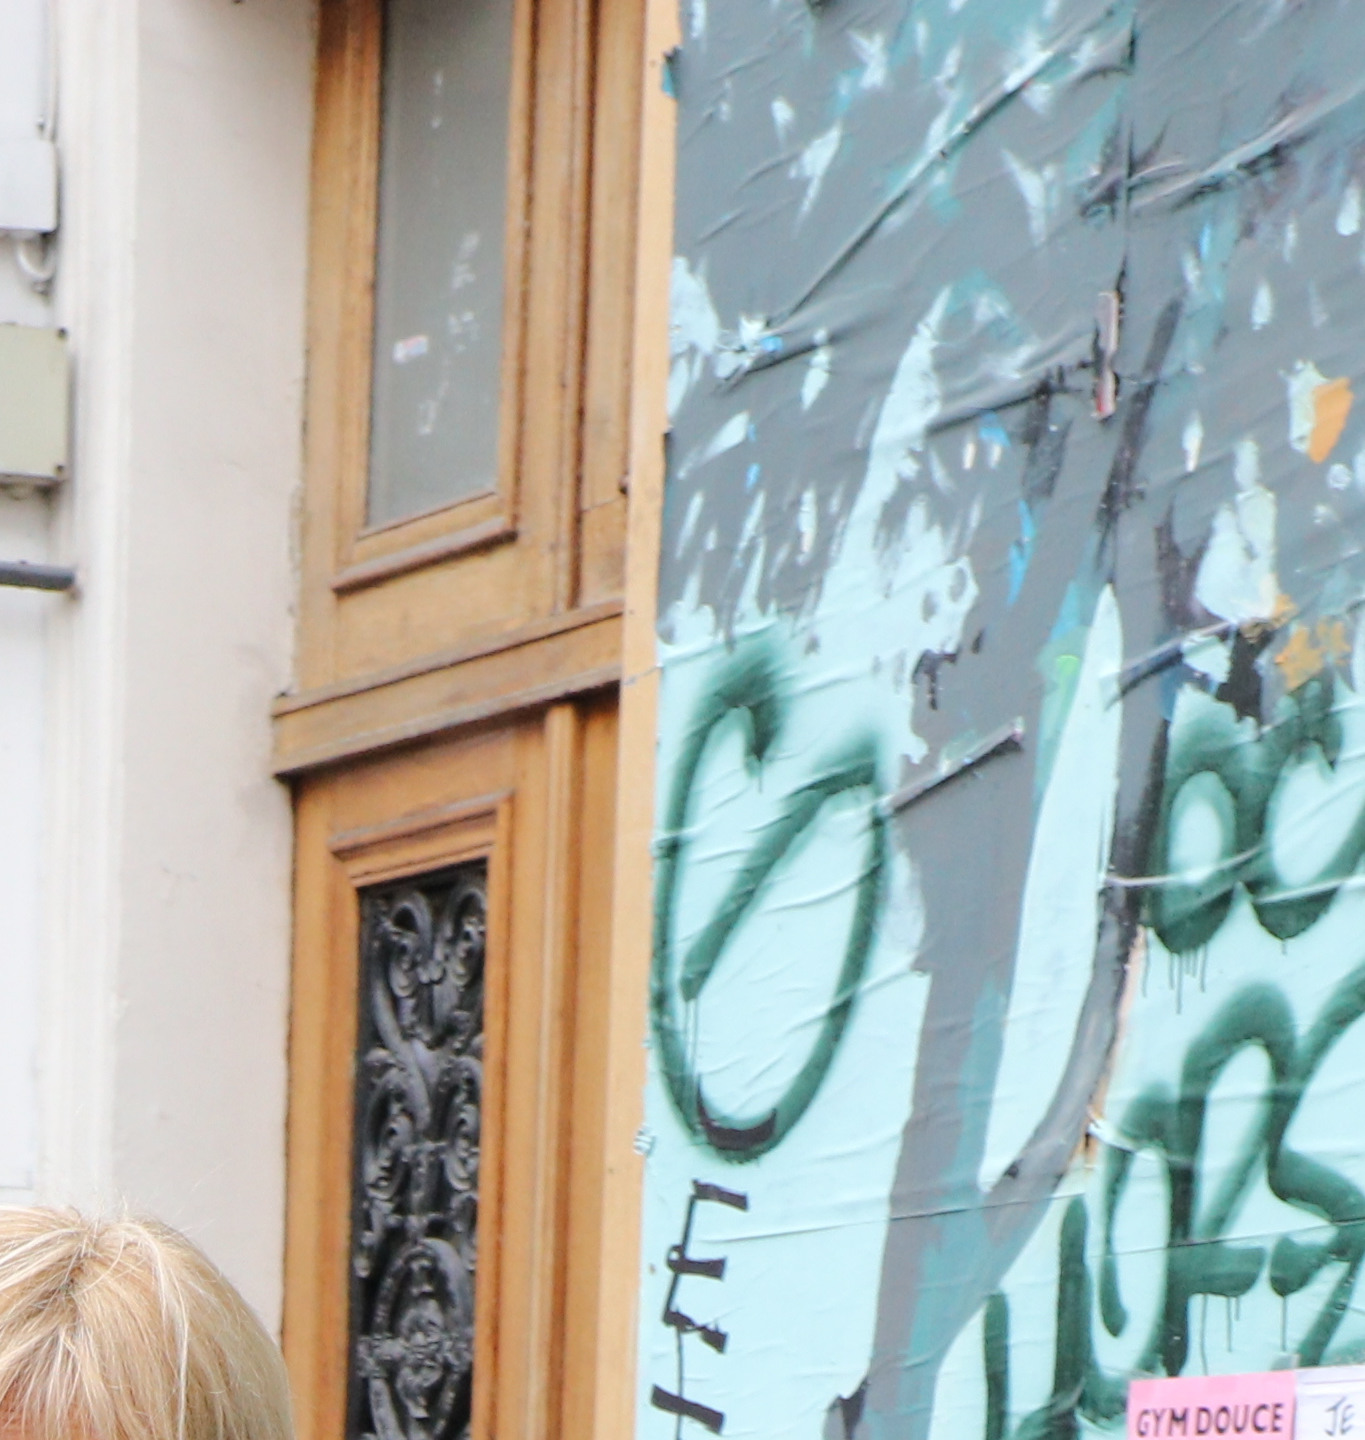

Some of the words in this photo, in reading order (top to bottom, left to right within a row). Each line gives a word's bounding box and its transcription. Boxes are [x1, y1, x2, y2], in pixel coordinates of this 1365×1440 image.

[1136, 1408, 1188, 1437] GYM
[1195, 1403, 1284, 1435] DOUCE
[1325, 1397, 1354, 1436] JE
